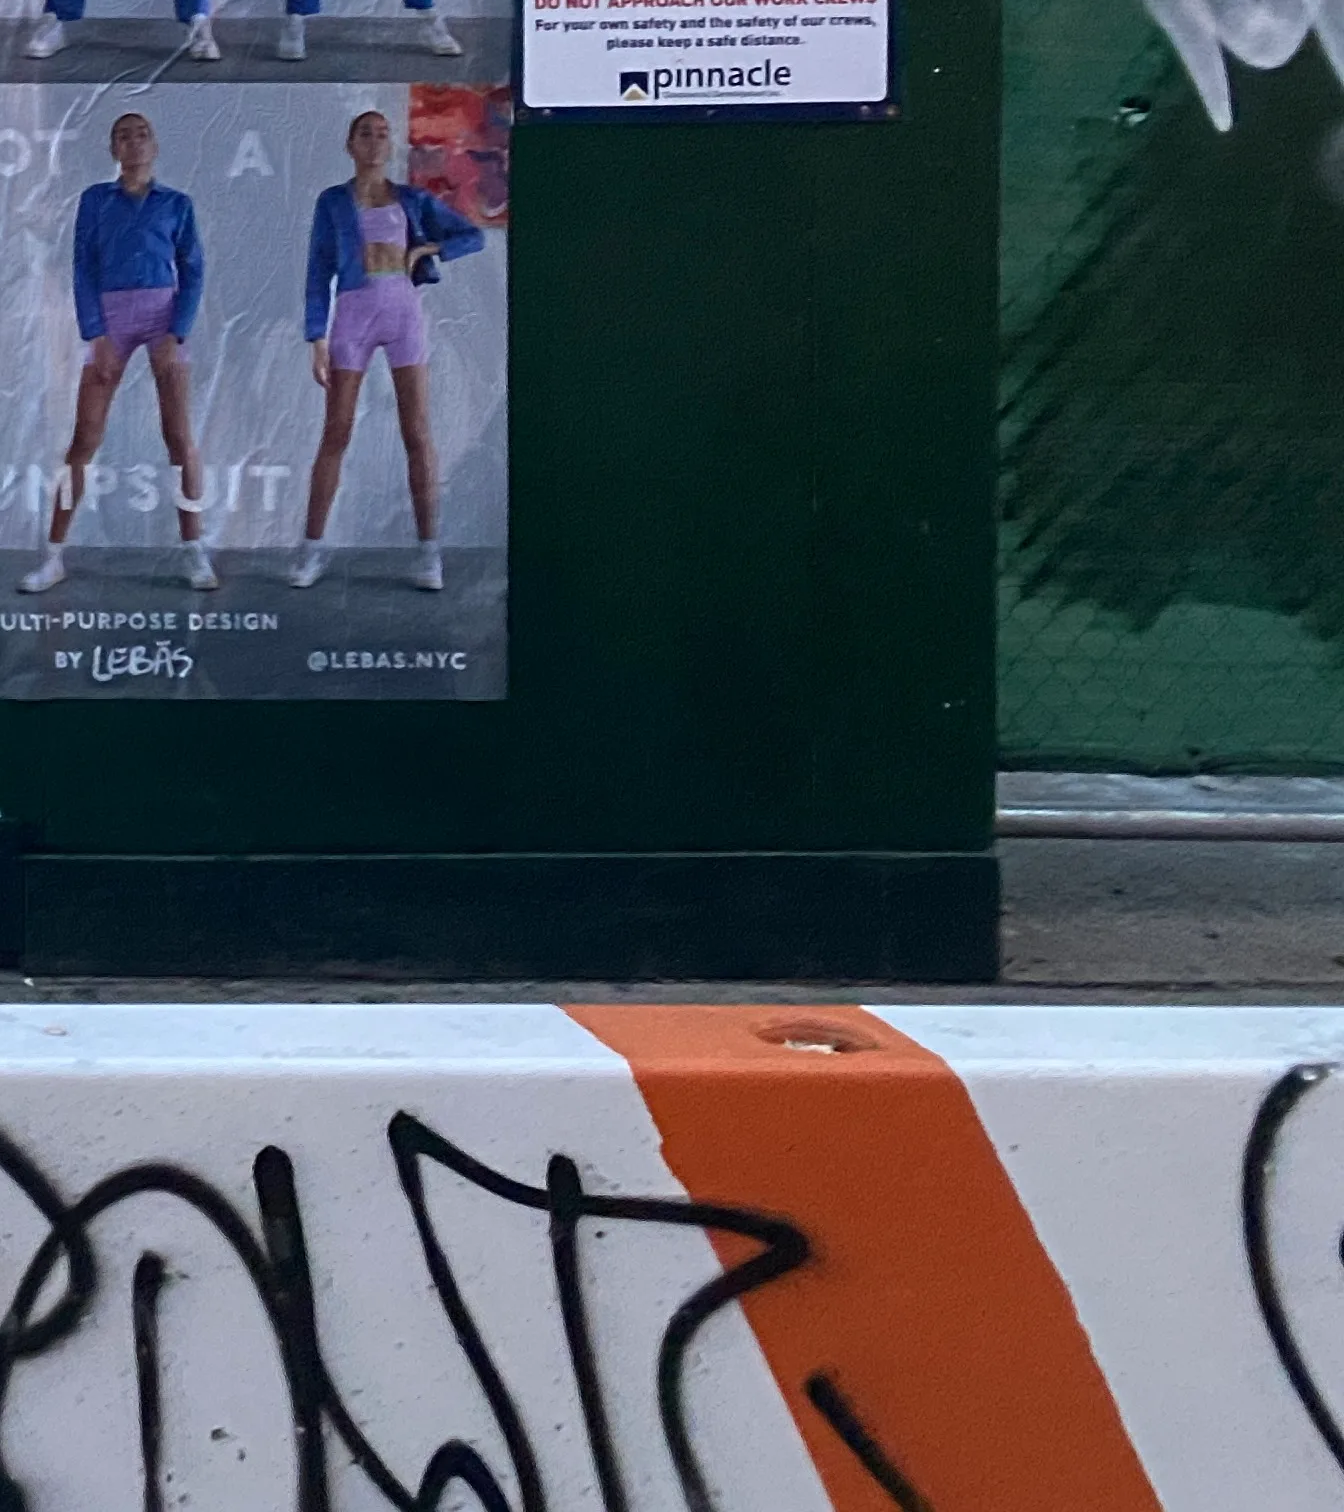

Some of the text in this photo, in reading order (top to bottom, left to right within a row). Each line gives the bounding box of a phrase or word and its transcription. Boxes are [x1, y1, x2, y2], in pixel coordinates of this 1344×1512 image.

[535, 19, 559, 31] For
[563, 21, 595, 32] your
[599, 21, 628, 30] own
[633, 18, 676, 31] safety
[680, 18, 705, 29] and
[710, 17, 732, 28] the
[737, 17, 780, 29] safety
[783, 16, 797, 26] of
[801, 17, 825, 26] our
[607, 38, 653, 50] please
[658, 37, 692, 49] keep
[695, 38, 703, 47] a
[707, 36, 736, 46] safe
[654, 59, 791, 99] pinnacle
[232, 130, 274, 178] A
[188, 611, 279, 632] DESIGN
[54, 651, 82, 670] BY
[307, 649, 467, 672] @LEBAS.NYC
